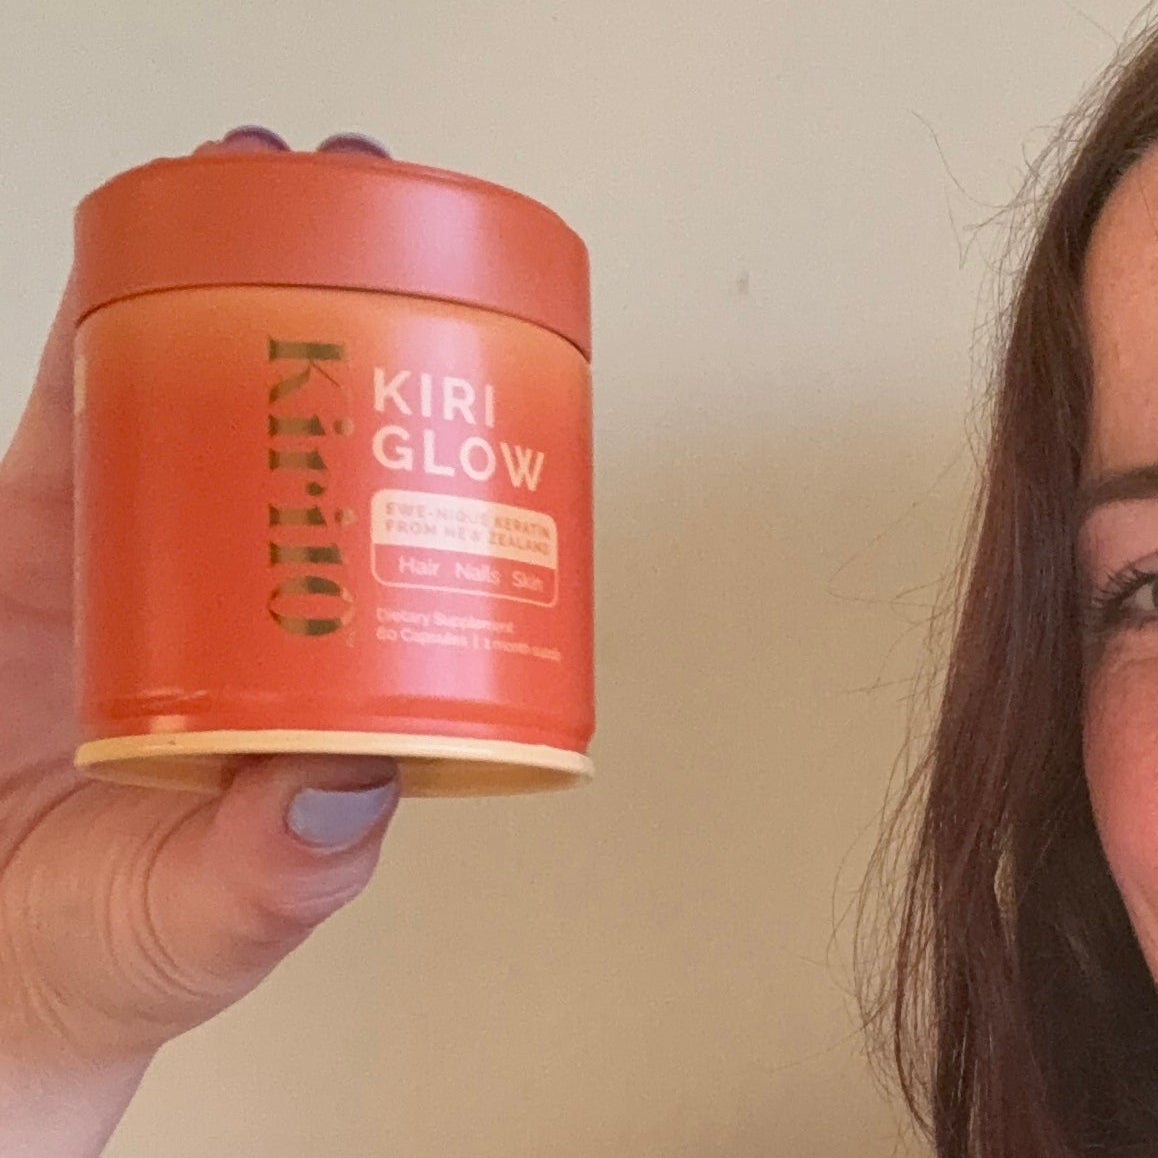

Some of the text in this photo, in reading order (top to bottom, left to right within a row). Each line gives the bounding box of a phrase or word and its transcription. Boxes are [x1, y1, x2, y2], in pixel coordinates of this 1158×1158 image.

[373, 367, 495, 428] KIRI
[372, 425, 545, 492] GLOW
[385, 519, 437, 535] FROM
[399, 555, 544, 592] Hair Nails Skin
